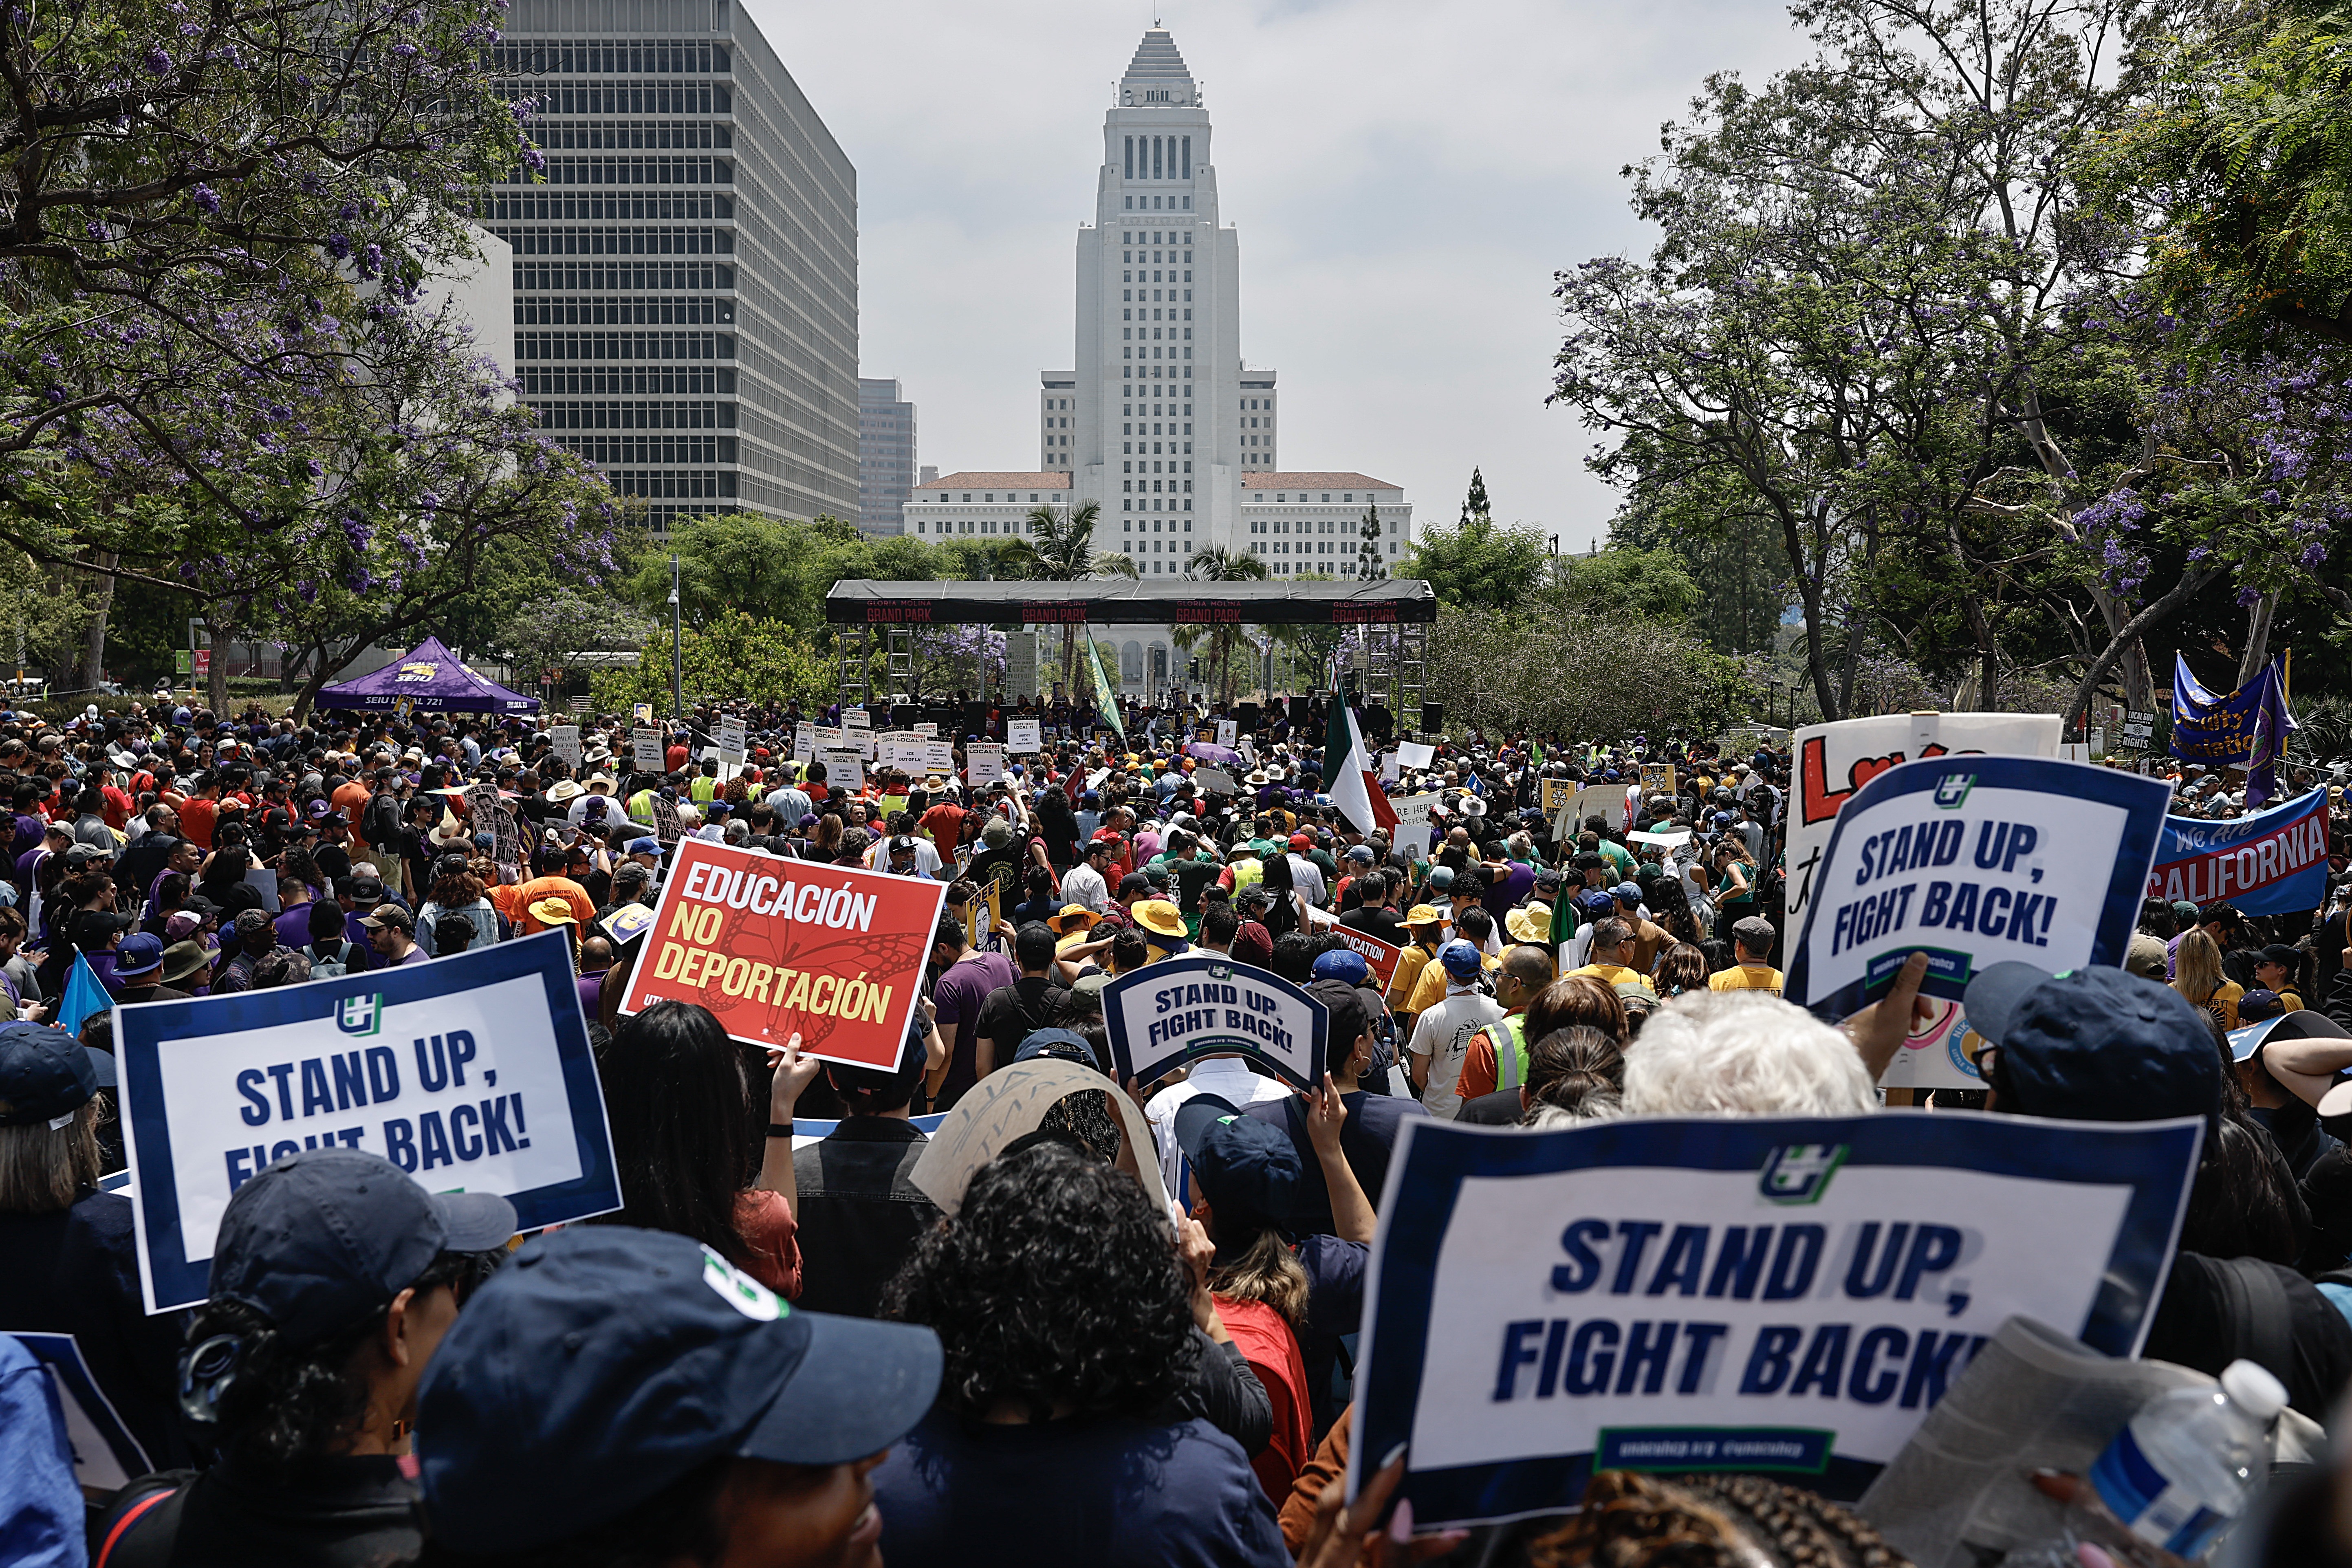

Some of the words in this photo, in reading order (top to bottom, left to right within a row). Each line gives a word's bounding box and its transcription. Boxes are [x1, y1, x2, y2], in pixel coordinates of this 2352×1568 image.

[867, 608, 902, 622] GRAND
[905, 608, 932, 622] PARK
[1022, 609, 1057, 622] GRAND
[1060, 608, 1087, 622] PARK
[1176, 609, 1211, 622] GRAND
[1214, 609, 1241, 622] PARK
[1332, 609, 1366, 623] GRAND
[1370, 609, 1397, 622] PARK
[400, 694, 414, 703] FREE
[2128, 711, 2143, 720] LOCAL
[2143, 713, 2154, 722] 600
[2123, 737, 2149, 749] RIGHTS
[463, 786, 480, 798] FREE
[482, 785, 497, 793] DAVID
[1550, 781, 1568, 789] IATSE
[655, 806, 682, 824] DAVID
[657, 819, 670, 827] END
[497, 821, 517, 841] DAVID
[2175, 827, 2205, 852] We
[2210, 818, 2256, 845] Are
[497, 836, 507, 848] END
[496, 846, 519, 864] RAIDS
[956, 851, 966, 859] FREE
[1856, 819, 1965, 885] STAND
[1974, 820, 2044, 883] UP,
[682, 861, 877, 932] EDUCACIÓN
[969, 882, 995, 912] FREE
[668, 901, 723, 945] NO
[1832, 883, 1916, 956] FIGHT
[1919, 881, 2058, 947] BACK!
[124, 951, 136, 964] LA
[653, 941, 893, 1024] DEPORTACIÓN
[1155, 984, 1237, 1013] STAND
[1246, 989, 1283, 1025] UP,
[1149, 1009, 1216, 1047] FIGHT
[1226, 1009, 1293, 1054] BACK!
[1952, 1049, 1965, 1067] LITTLE
[236, 1045, 400, 1126] STAND
[414, 1029, 497, 1088] UP,
[383, 1092, 531, 1174] BACK!
[1548, 1217, 1826, 1302] STAND
[1844, 1222, 1972, 1318] UP,
[1493, 1320, 1727, 1403] FIGHT
